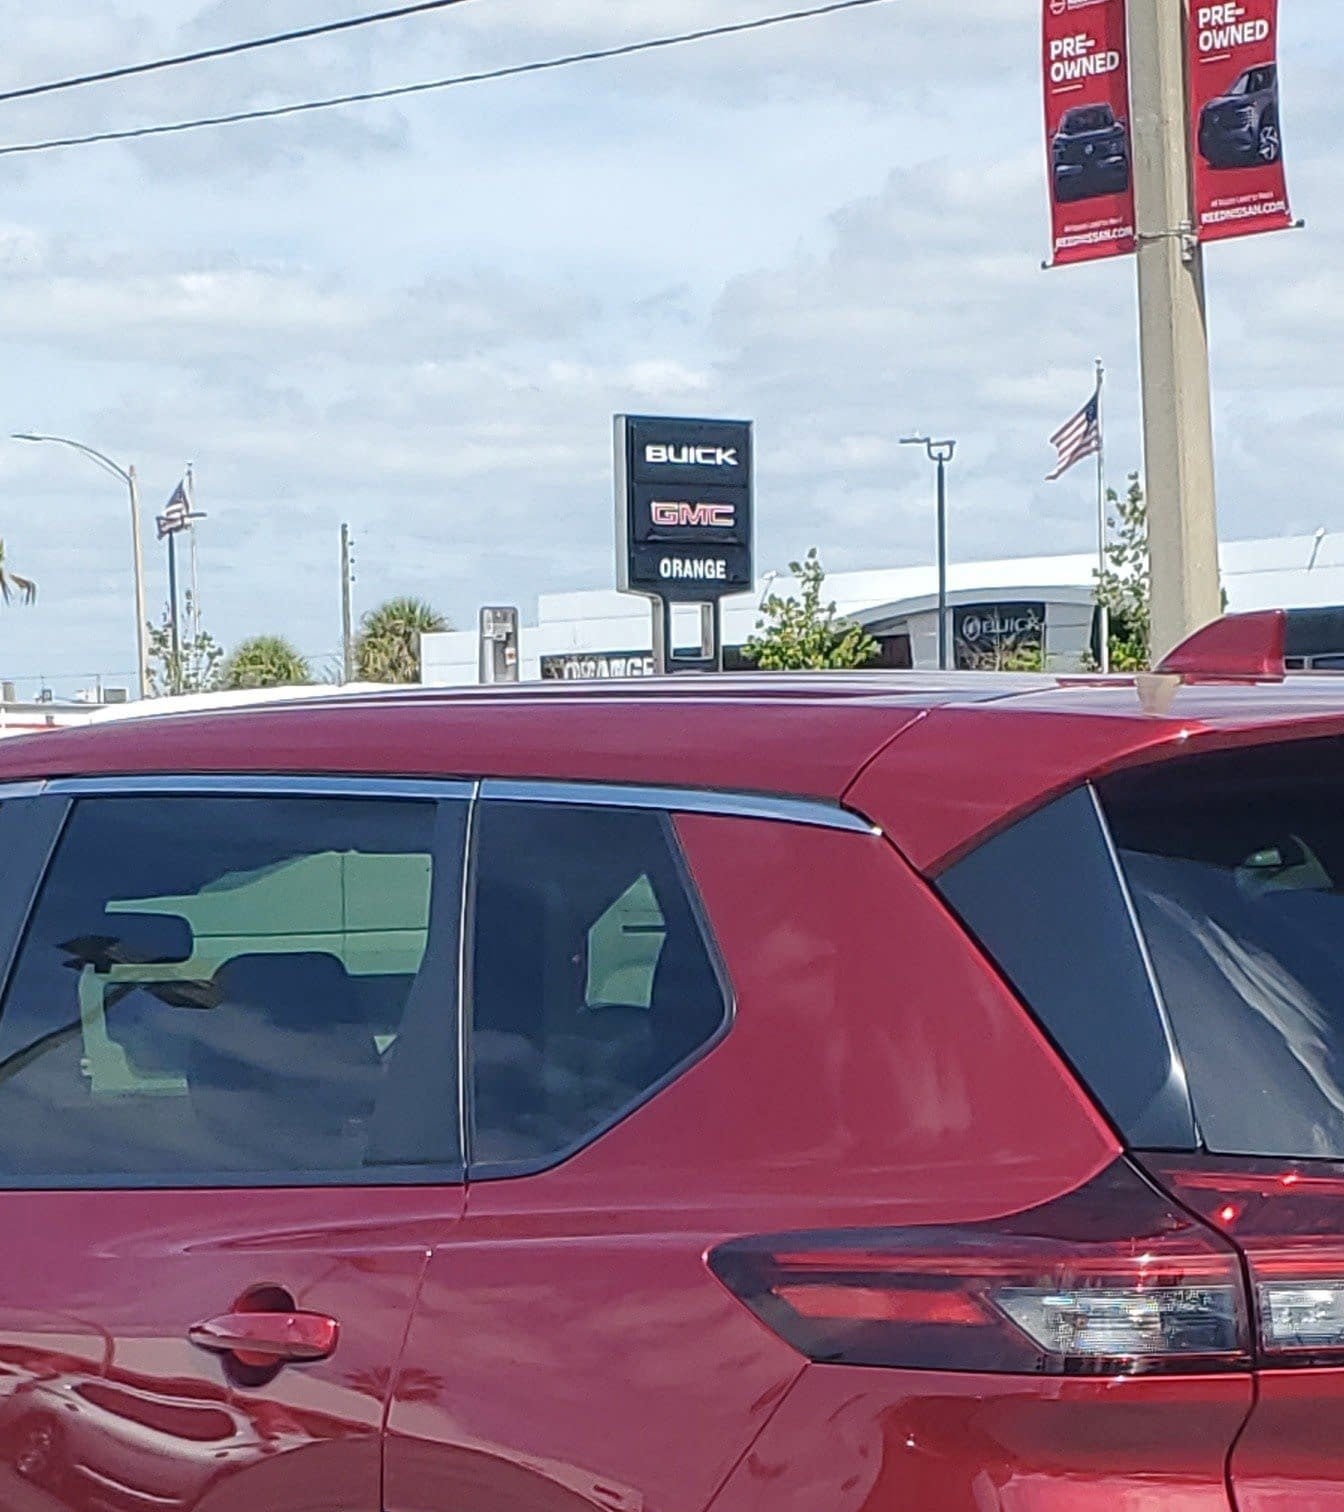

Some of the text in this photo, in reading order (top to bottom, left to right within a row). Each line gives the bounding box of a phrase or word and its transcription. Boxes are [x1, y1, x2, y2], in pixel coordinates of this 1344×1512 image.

[1199, 2, 1245, 28] PRE-
[1050, 33, 1096, 61] PRE-
[1199, 19, 1270, 51] OWNED
[1051, 51, 1120, 83] OWNED
[645, 444, 738, 466] BUICK
[650, 501, 736, 527] GMC
[659, 557, 727, 580] ORANGE
